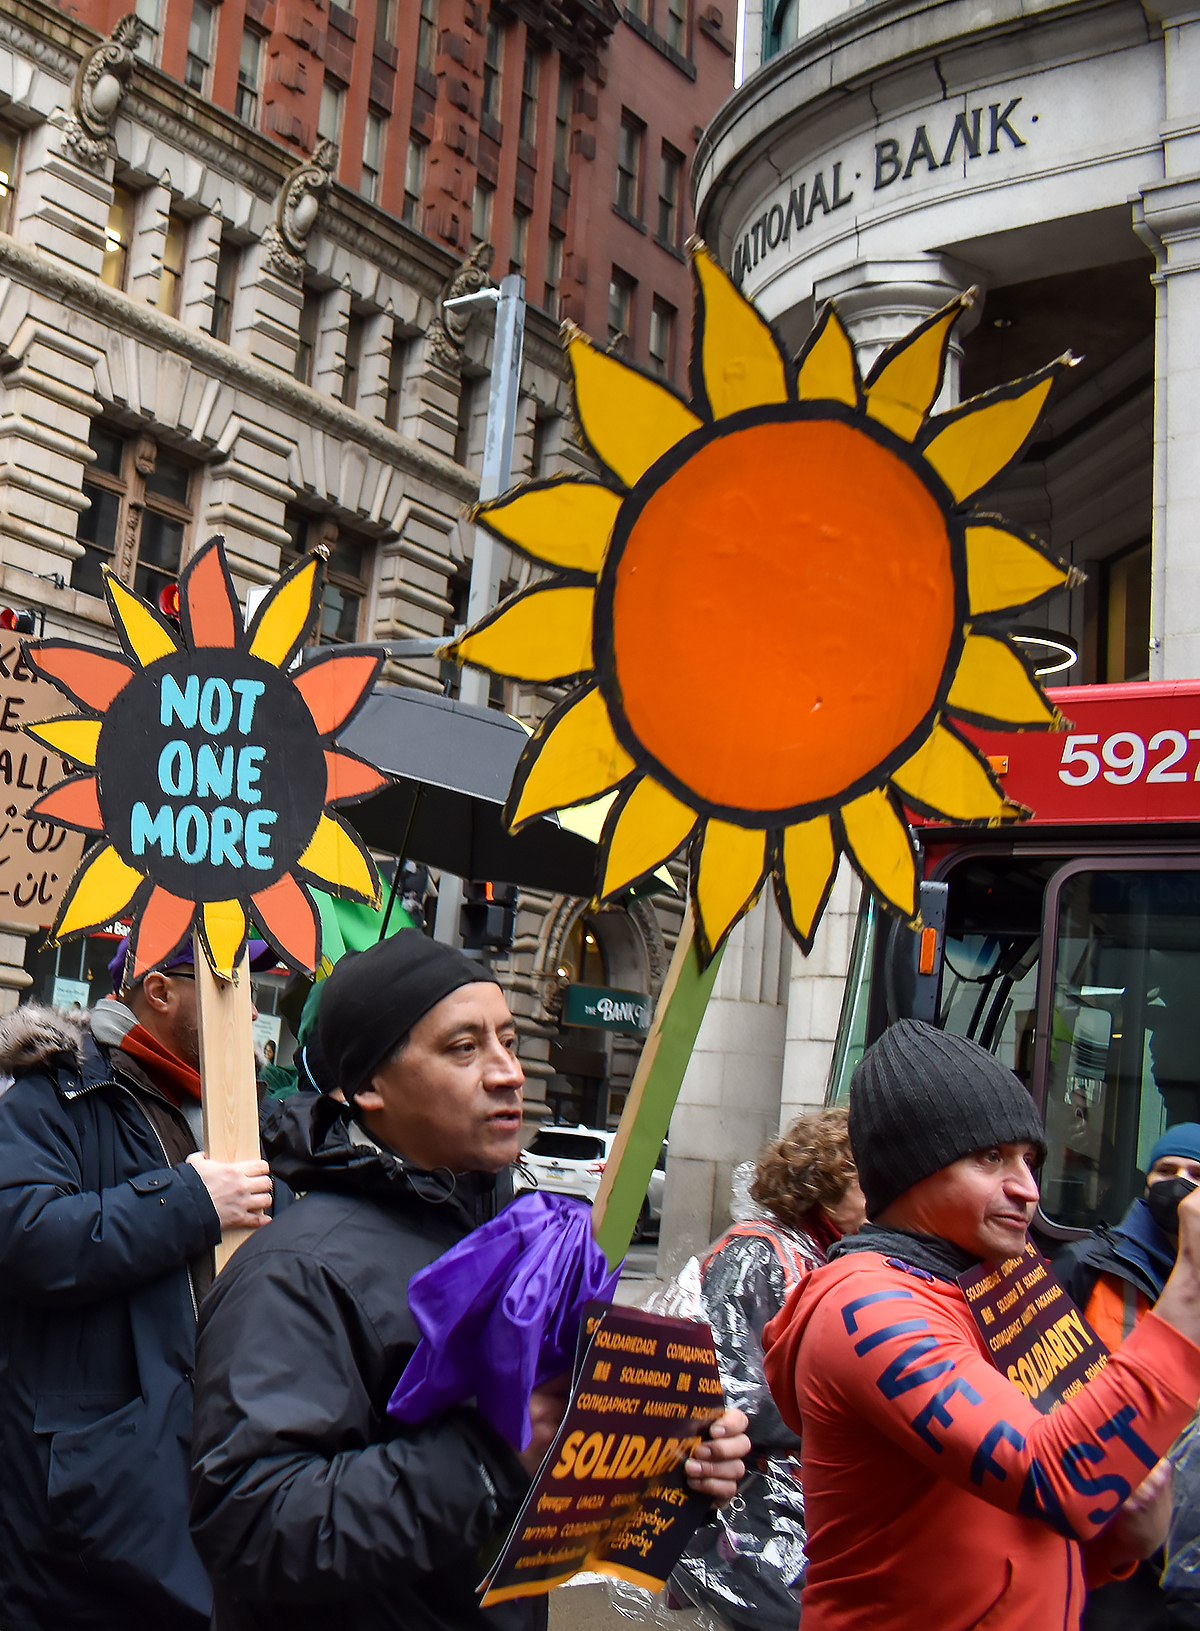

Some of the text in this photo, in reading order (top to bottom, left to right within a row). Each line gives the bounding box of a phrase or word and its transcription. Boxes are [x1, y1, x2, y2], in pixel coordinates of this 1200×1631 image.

[874, 98, 1027, 190] BANK
[160, 674, 266, 735] NOT
[158, 740, 266, 805] ONE
[130, 803, 279, 871] MORE
[594, 1330, 657, 1356] SOLIDARIEDADE
[1006, 1308, 1094, 1402] SOLIDARITY
[620, 1366, 671, 1388] SOLIDARIDAD
[841, 1290, 1161, 1541] LIVE FAST
